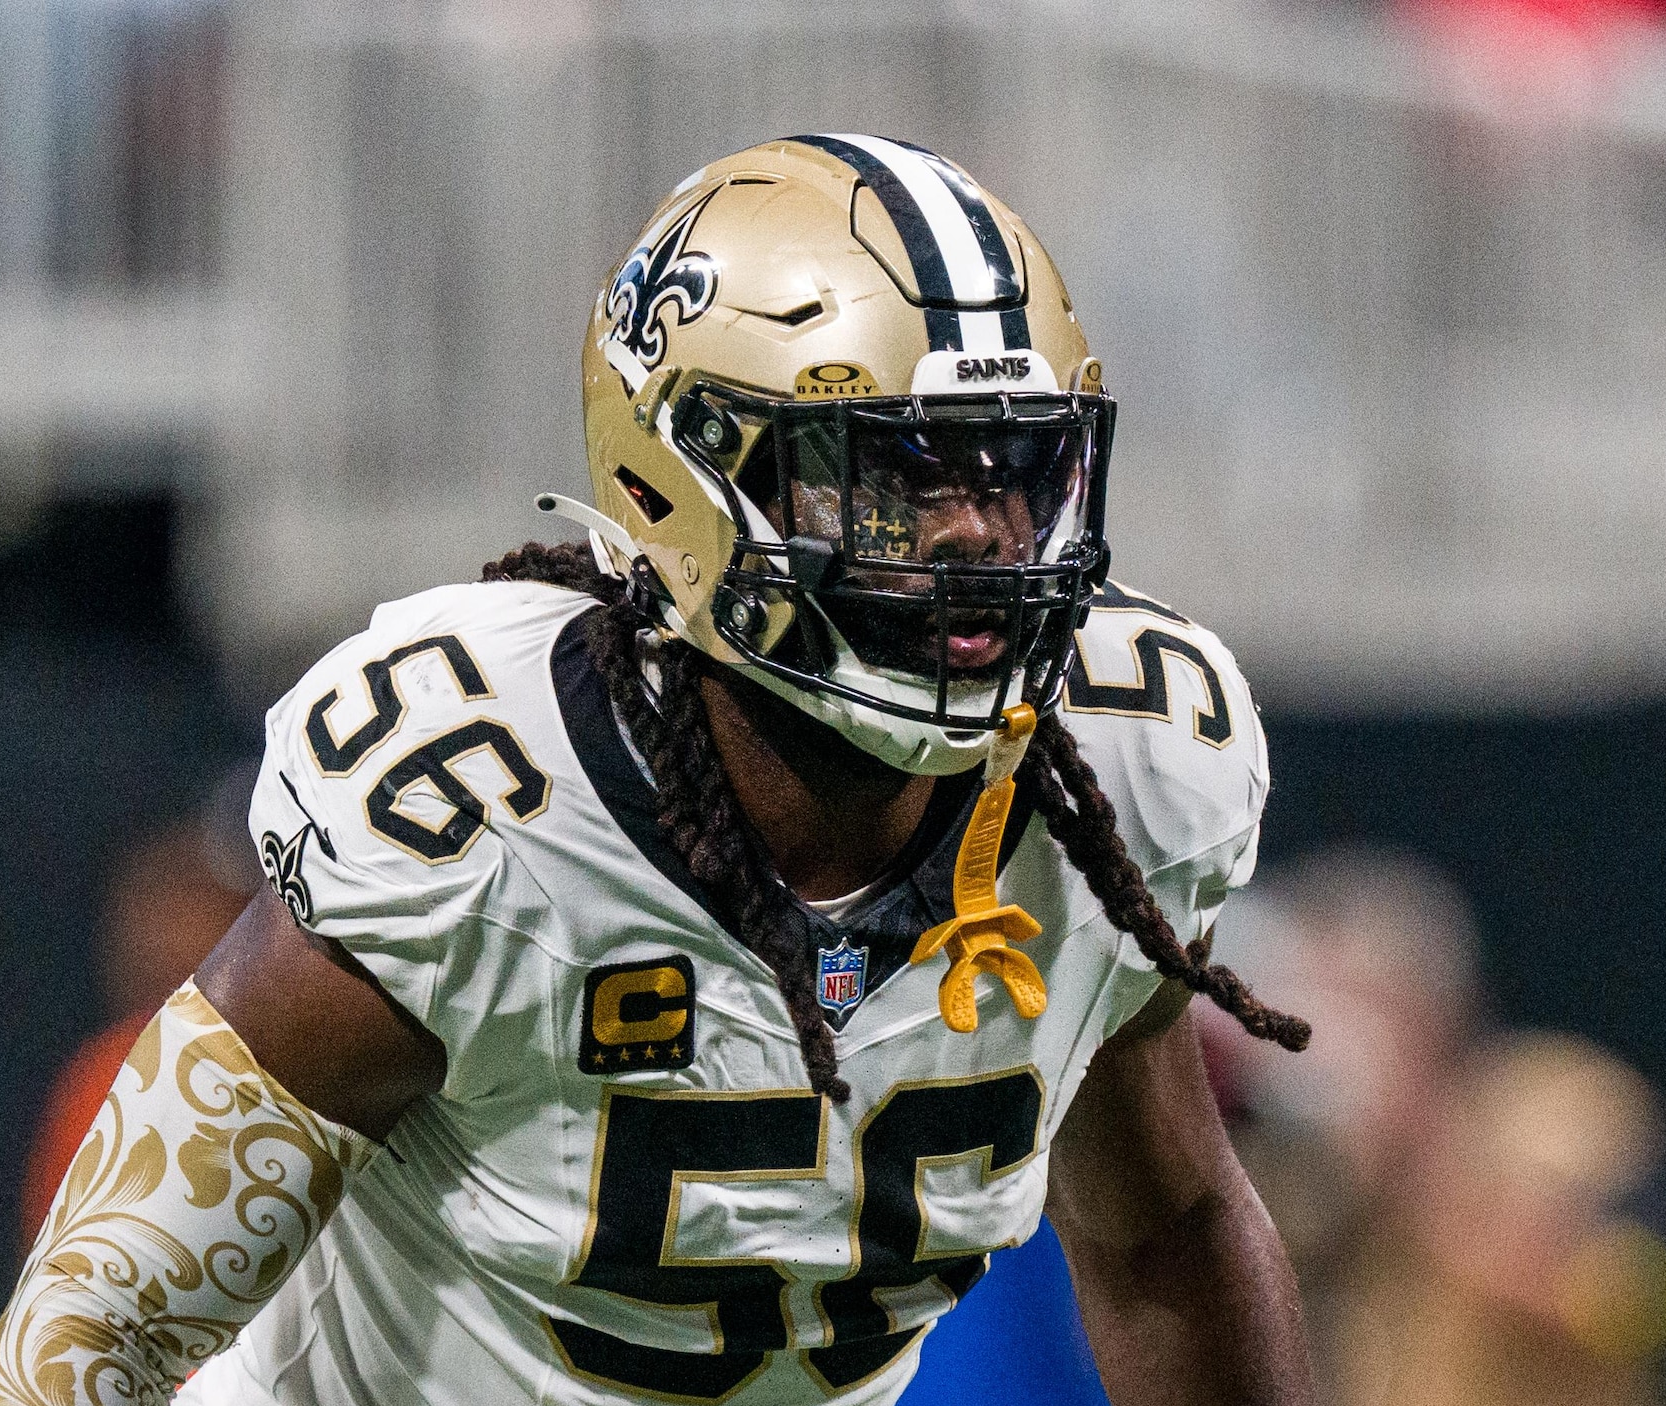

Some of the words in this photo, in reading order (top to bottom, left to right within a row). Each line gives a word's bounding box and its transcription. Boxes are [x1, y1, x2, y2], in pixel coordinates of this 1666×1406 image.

[796, 385, 873, 395] OAKLEY
[956, 356, 1031, 380] SAINTS
[1062, 578, 1236, 751] 5
[300, 631, 553, 867] 56
[592, 966, 688, 1046] C
[825, 975, 857, 1003] NFL
[538, 1062, 1047, 1406] 56
